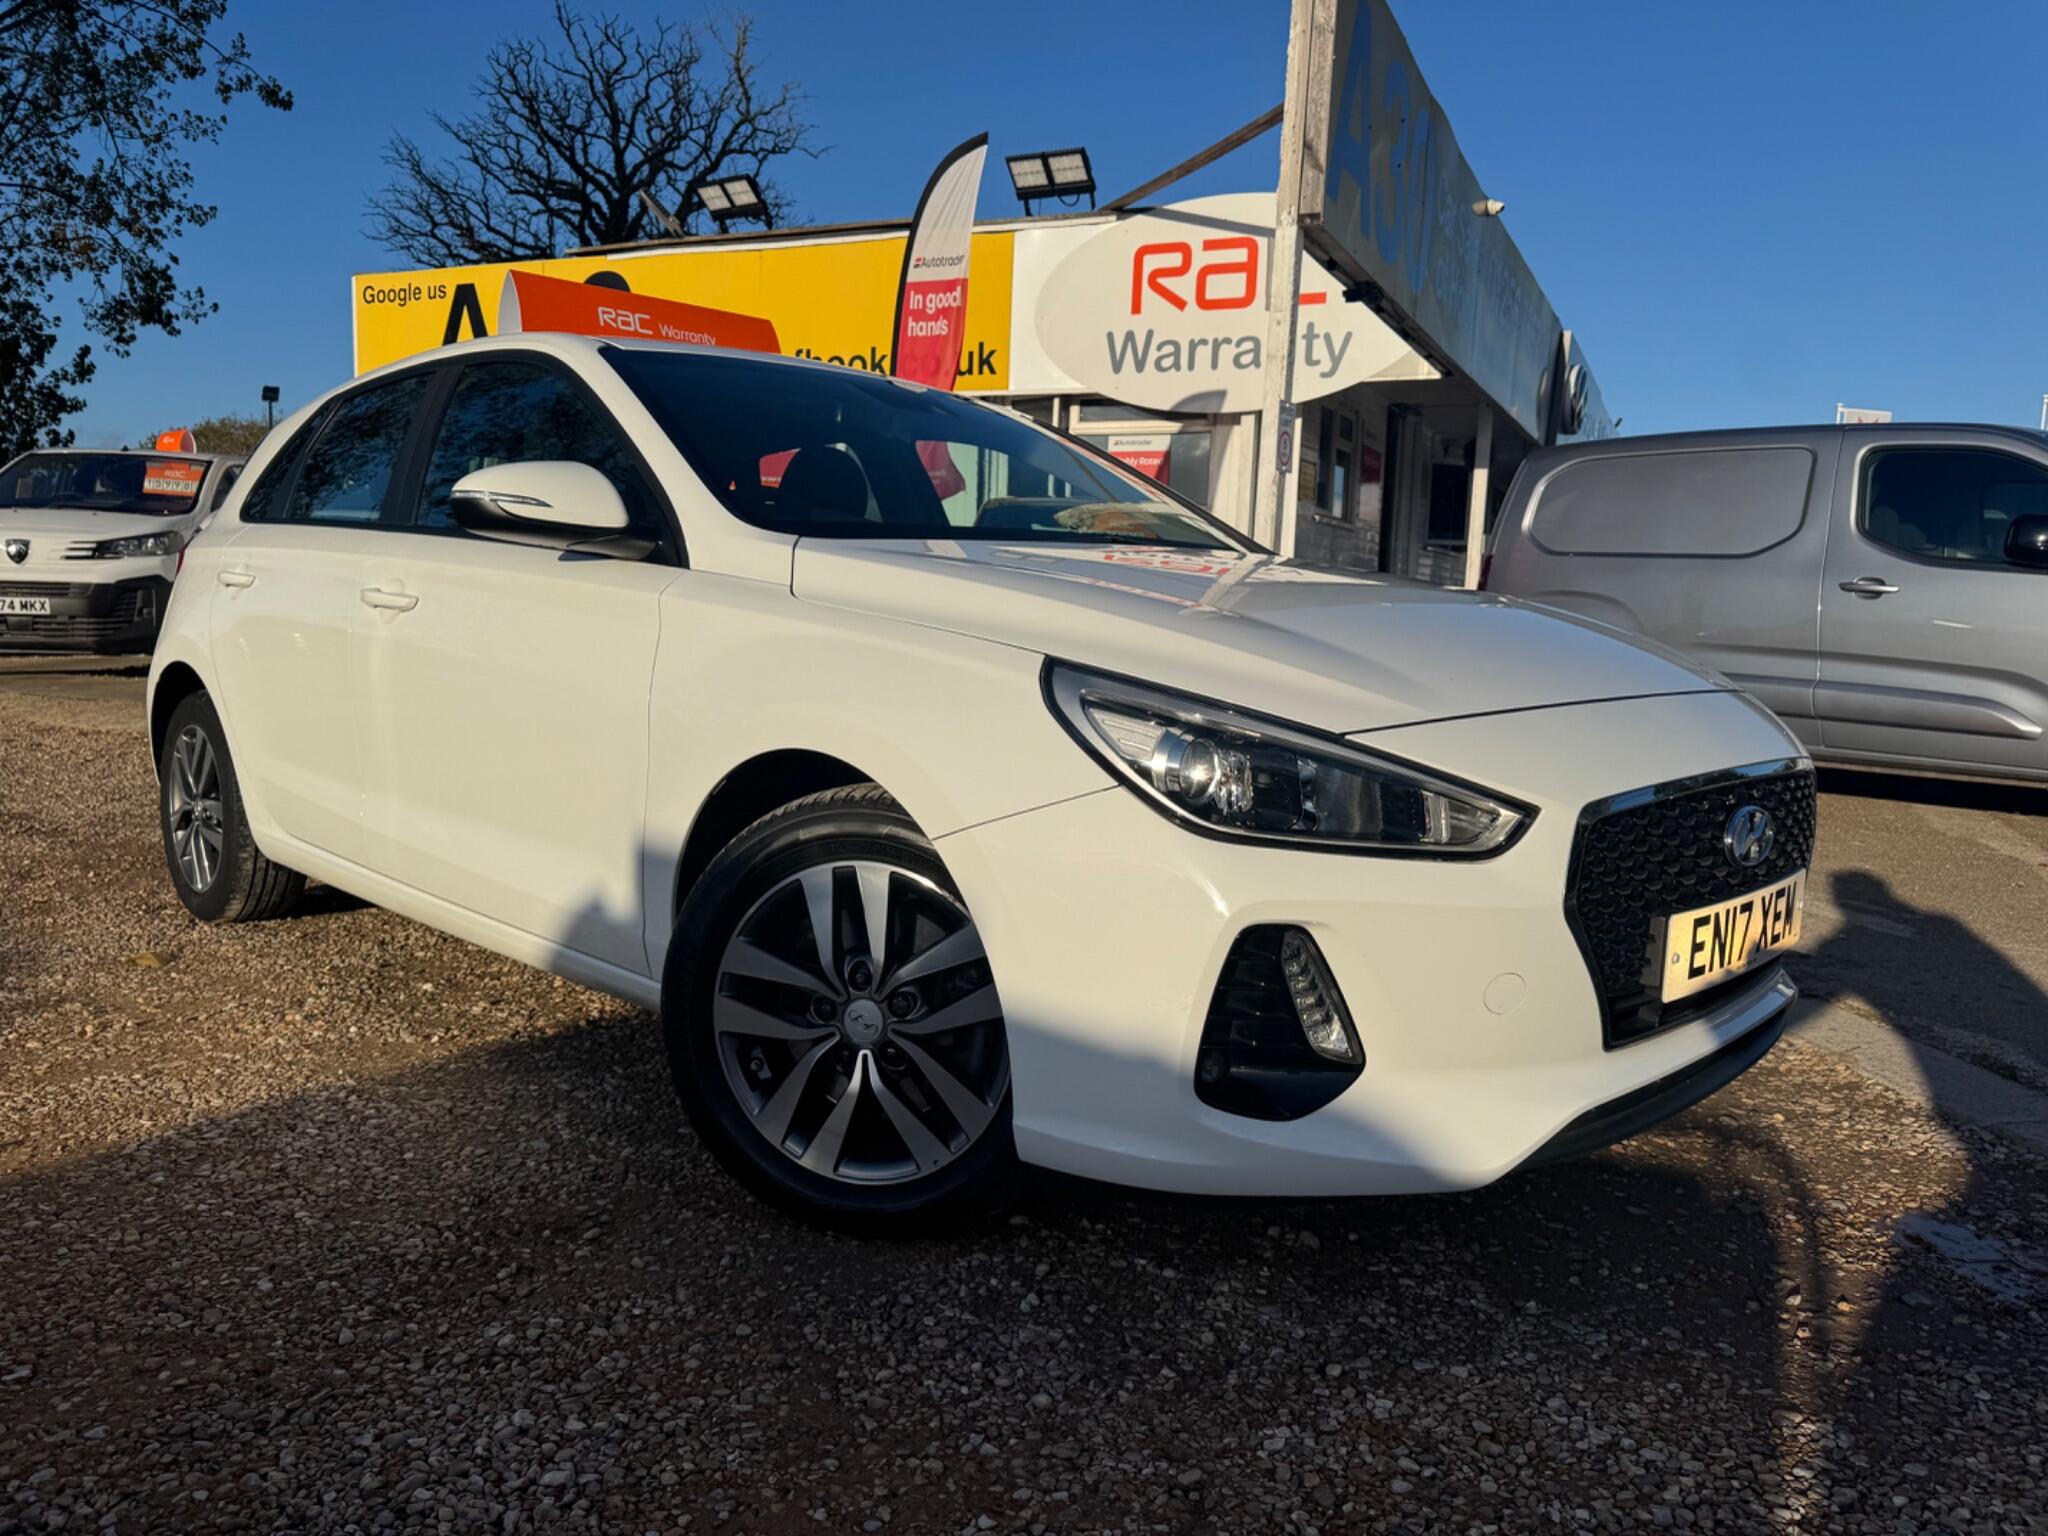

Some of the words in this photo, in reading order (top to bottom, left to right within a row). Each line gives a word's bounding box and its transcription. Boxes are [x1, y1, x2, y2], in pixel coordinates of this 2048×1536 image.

[362, 283, 422, 307] Google
[427, 284, 447, 300] us
[910, 290, 923, 310] In
[926, 285, 962, 314] good
[659, 324, 717, 346] Warranty
[1106, 328, 1353, 379] Warraty
[20, 600, 47, 612] MKX
[1688, 901, 1754, 979] EN17
[1757, 882, 1797, 953] XEM
